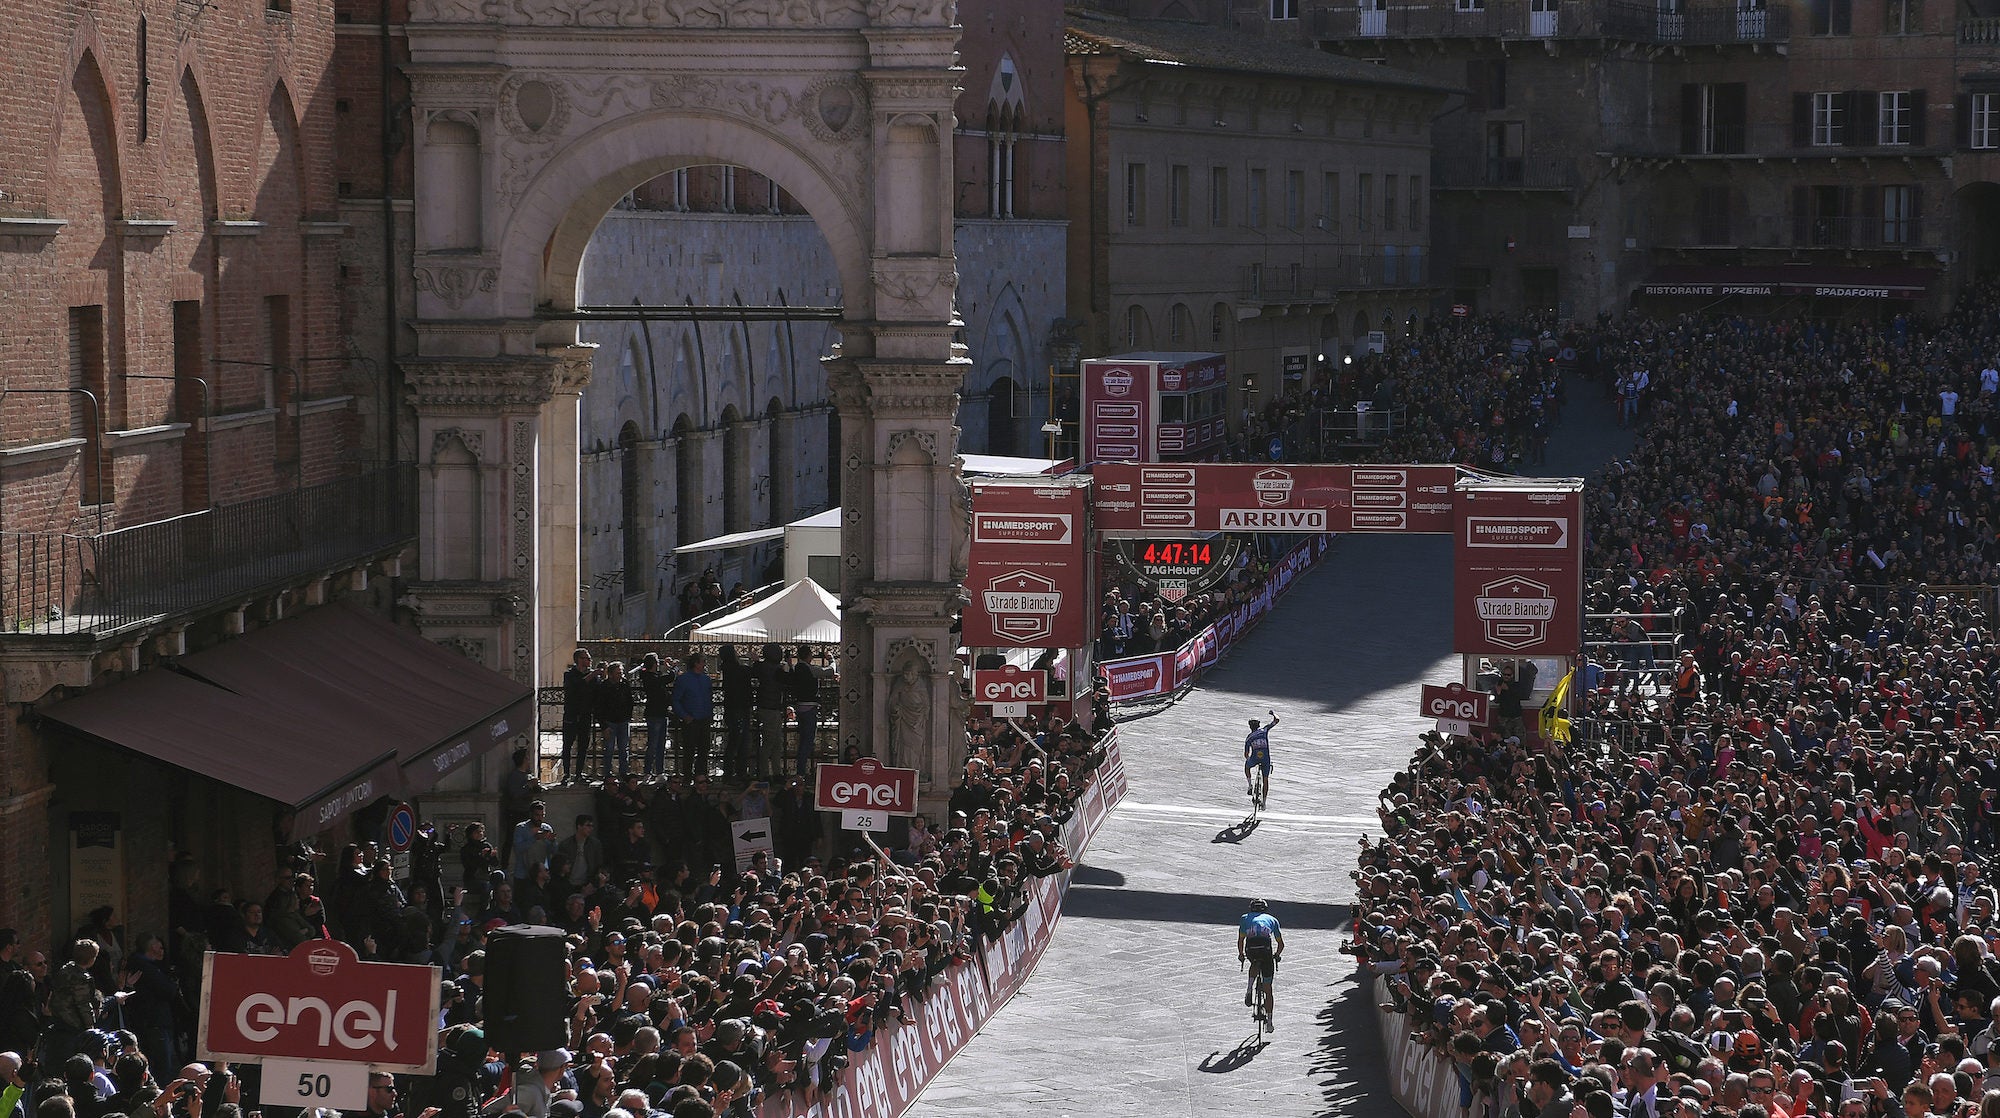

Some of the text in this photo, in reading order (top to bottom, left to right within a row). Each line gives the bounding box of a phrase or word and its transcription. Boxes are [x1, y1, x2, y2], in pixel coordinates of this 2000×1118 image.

[1645, 287, 1772, 295] RISTORANTE PIZZERIA
[1815, 288, 1889, 298] SPADAFORTE
[991, 521, 1054, 531] NAMEDSPORT
[1224, 512, 1322, 527] ARRIVO
[1485, 525, 1550, 534] NAMEDSPORT
[1144, 543, 1211, 565] 4:47:14
[1161, 580, 1185, 588] TAG
[1161, 589, 1185, 600] HEUER
[990, 595, 1055, 610] Strade Bianche
[1482, 601, 1549, 616] Strade Bianche
[984, 677, 1037, 699] enel
[1003, 706, 1015, 714] 10
[1430, 698, 1479, 719] enel
[1448, 723, 1458, 732] 10
[831, 779, 901, 806] enel
[857, 816, 872, 827] 25
[957, 954, 990, 1031] enel
[235, 989, 398, 1052] enel
[924, 979, 961, 1064] enel
[890, 1006, 928, 1102] enel
[297, 1073, 331, 1098] 50
[855, 1045, 893, 1118] enel
